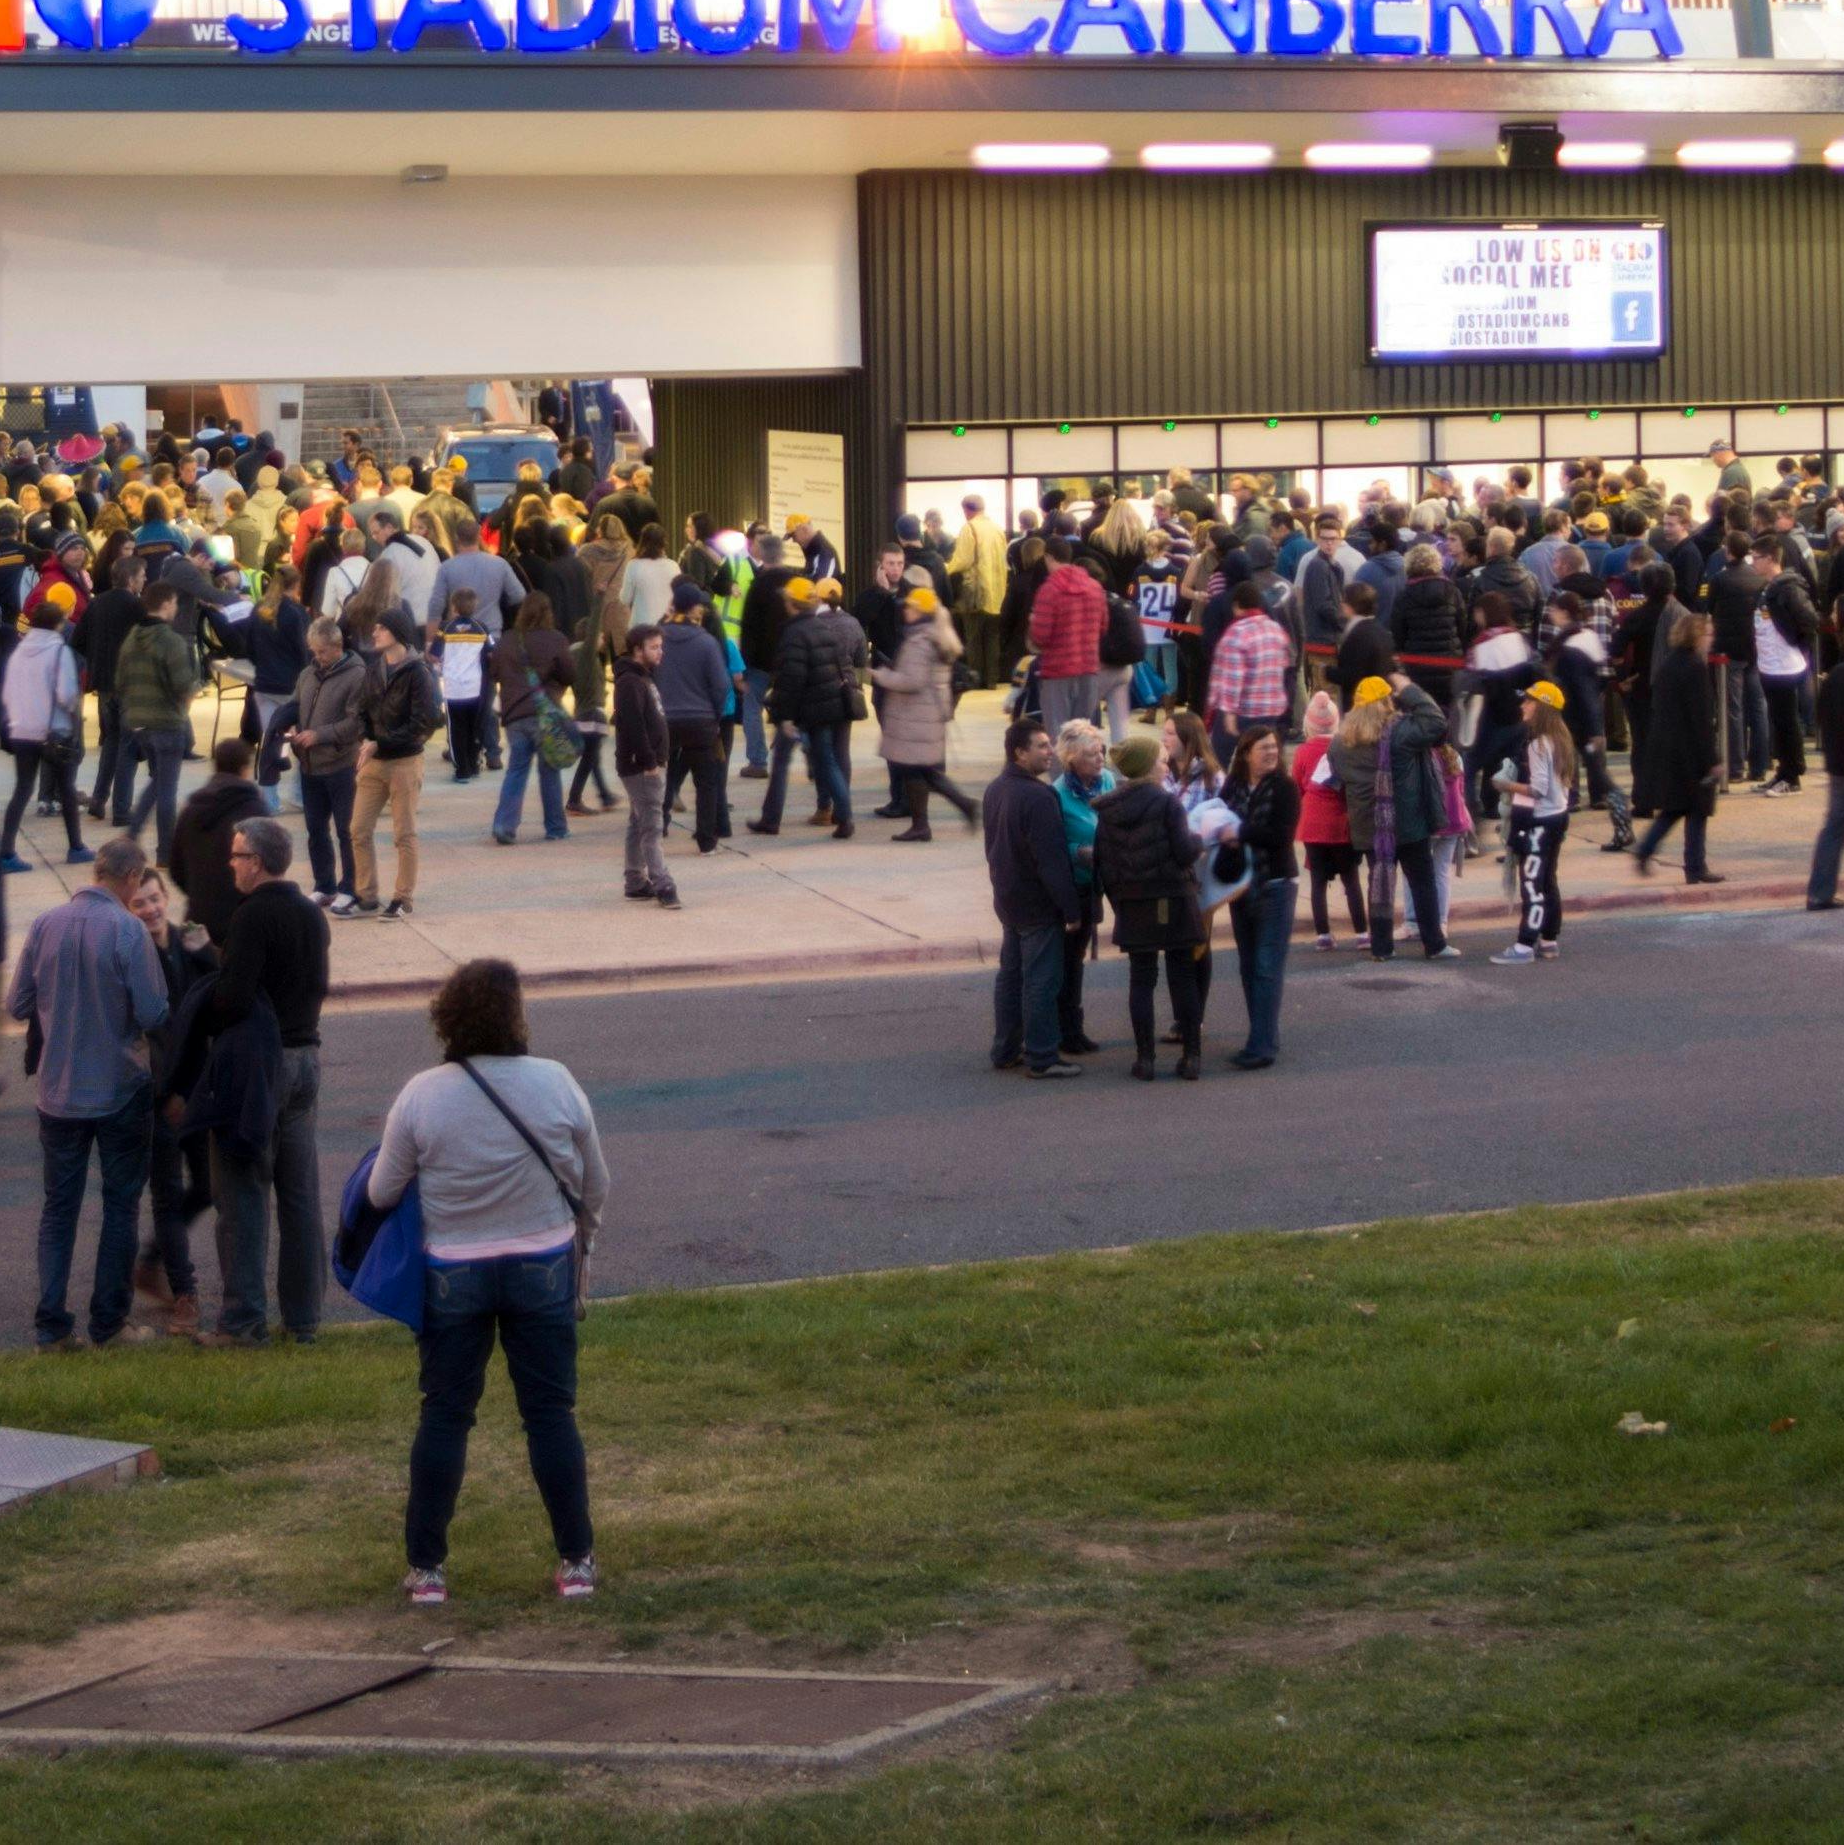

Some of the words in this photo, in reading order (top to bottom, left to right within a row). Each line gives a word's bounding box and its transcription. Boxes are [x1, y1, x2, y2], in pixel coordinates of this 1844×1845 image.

[1476, 238, 1524, 263] LOW
[1535, 238, 1562, 263] US
[1530, 264, 1572, 288] MED
